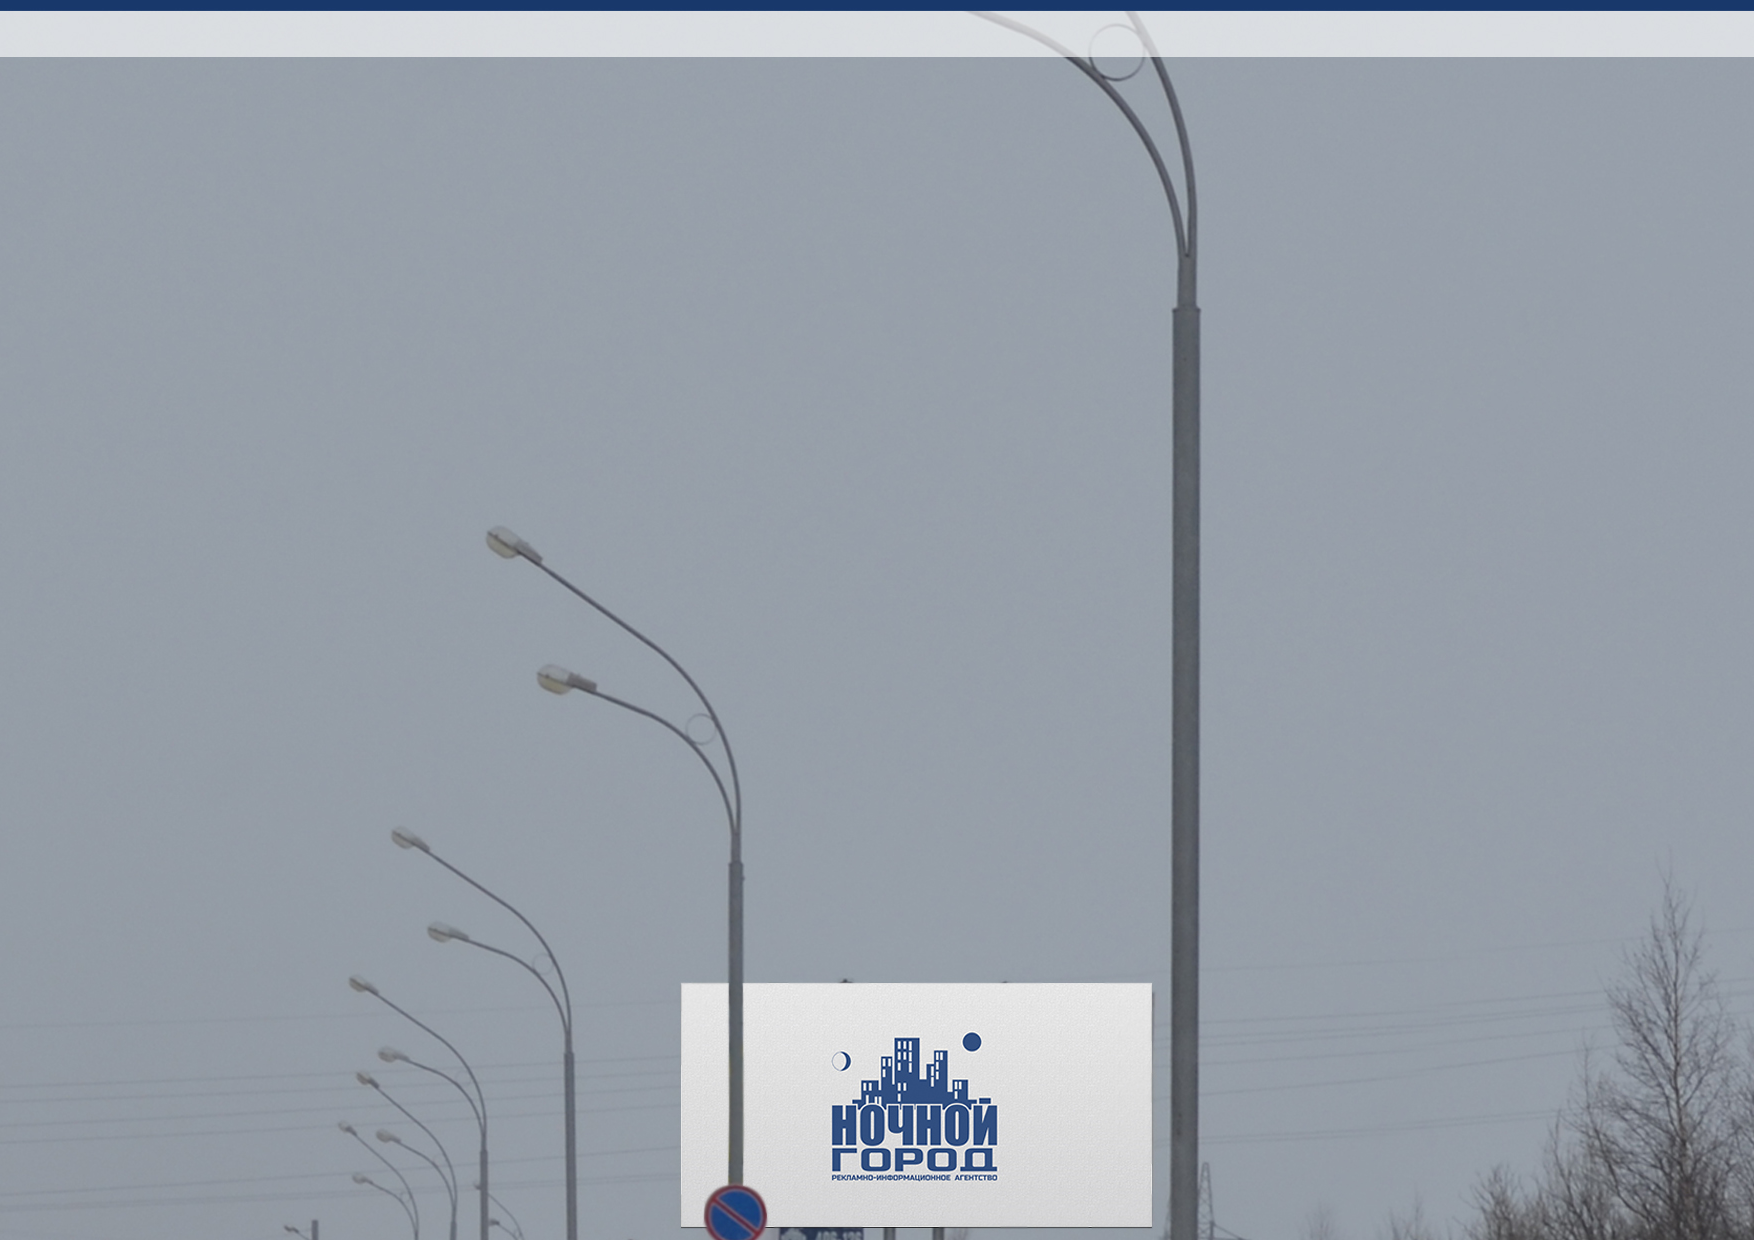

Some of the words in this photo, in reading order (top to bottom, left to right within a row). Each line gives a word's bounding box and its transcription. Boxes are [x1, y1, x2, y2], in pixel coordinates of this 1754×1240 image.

[832, 1098, 998, 1146] НОЧНОЙ
[832, 1148, 998, 1172] ГОРОД
[832, 1173, 952, 1182] РЕКЛАМНО-ИНФОРМАЦИОННОЕ
[954, 1173, 998, 1182] АГЕНТСТВО
